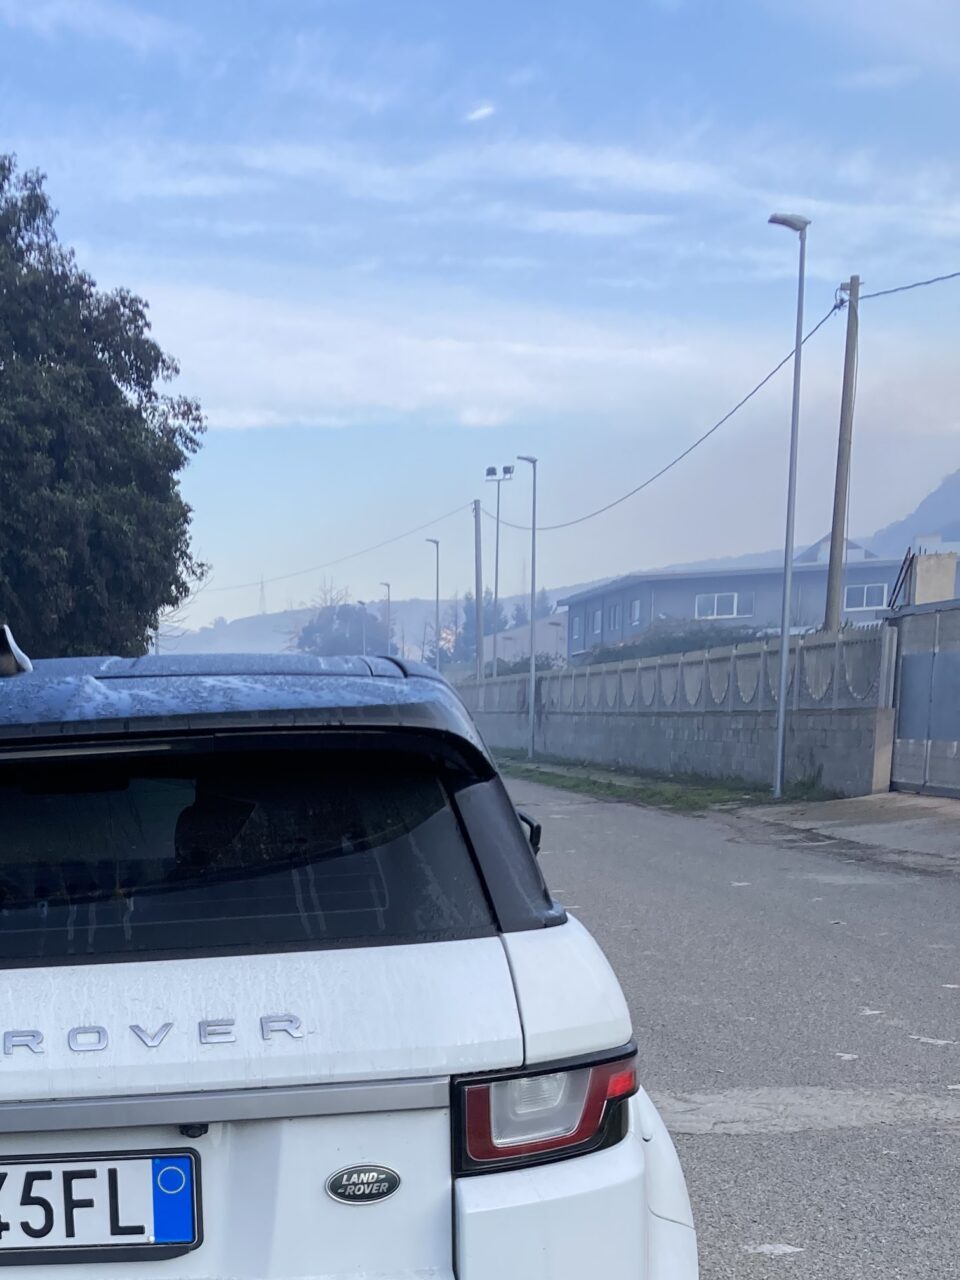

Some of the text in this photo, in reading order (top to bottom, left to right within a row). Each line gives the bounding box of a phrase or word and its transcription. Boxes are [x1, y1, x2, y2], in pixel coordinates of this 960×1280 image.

[3, 1014, 303, 1055] ROVER
[342, 1172, 377, 1184] LAND
[345, 1183, 388, 1196] ROVER
